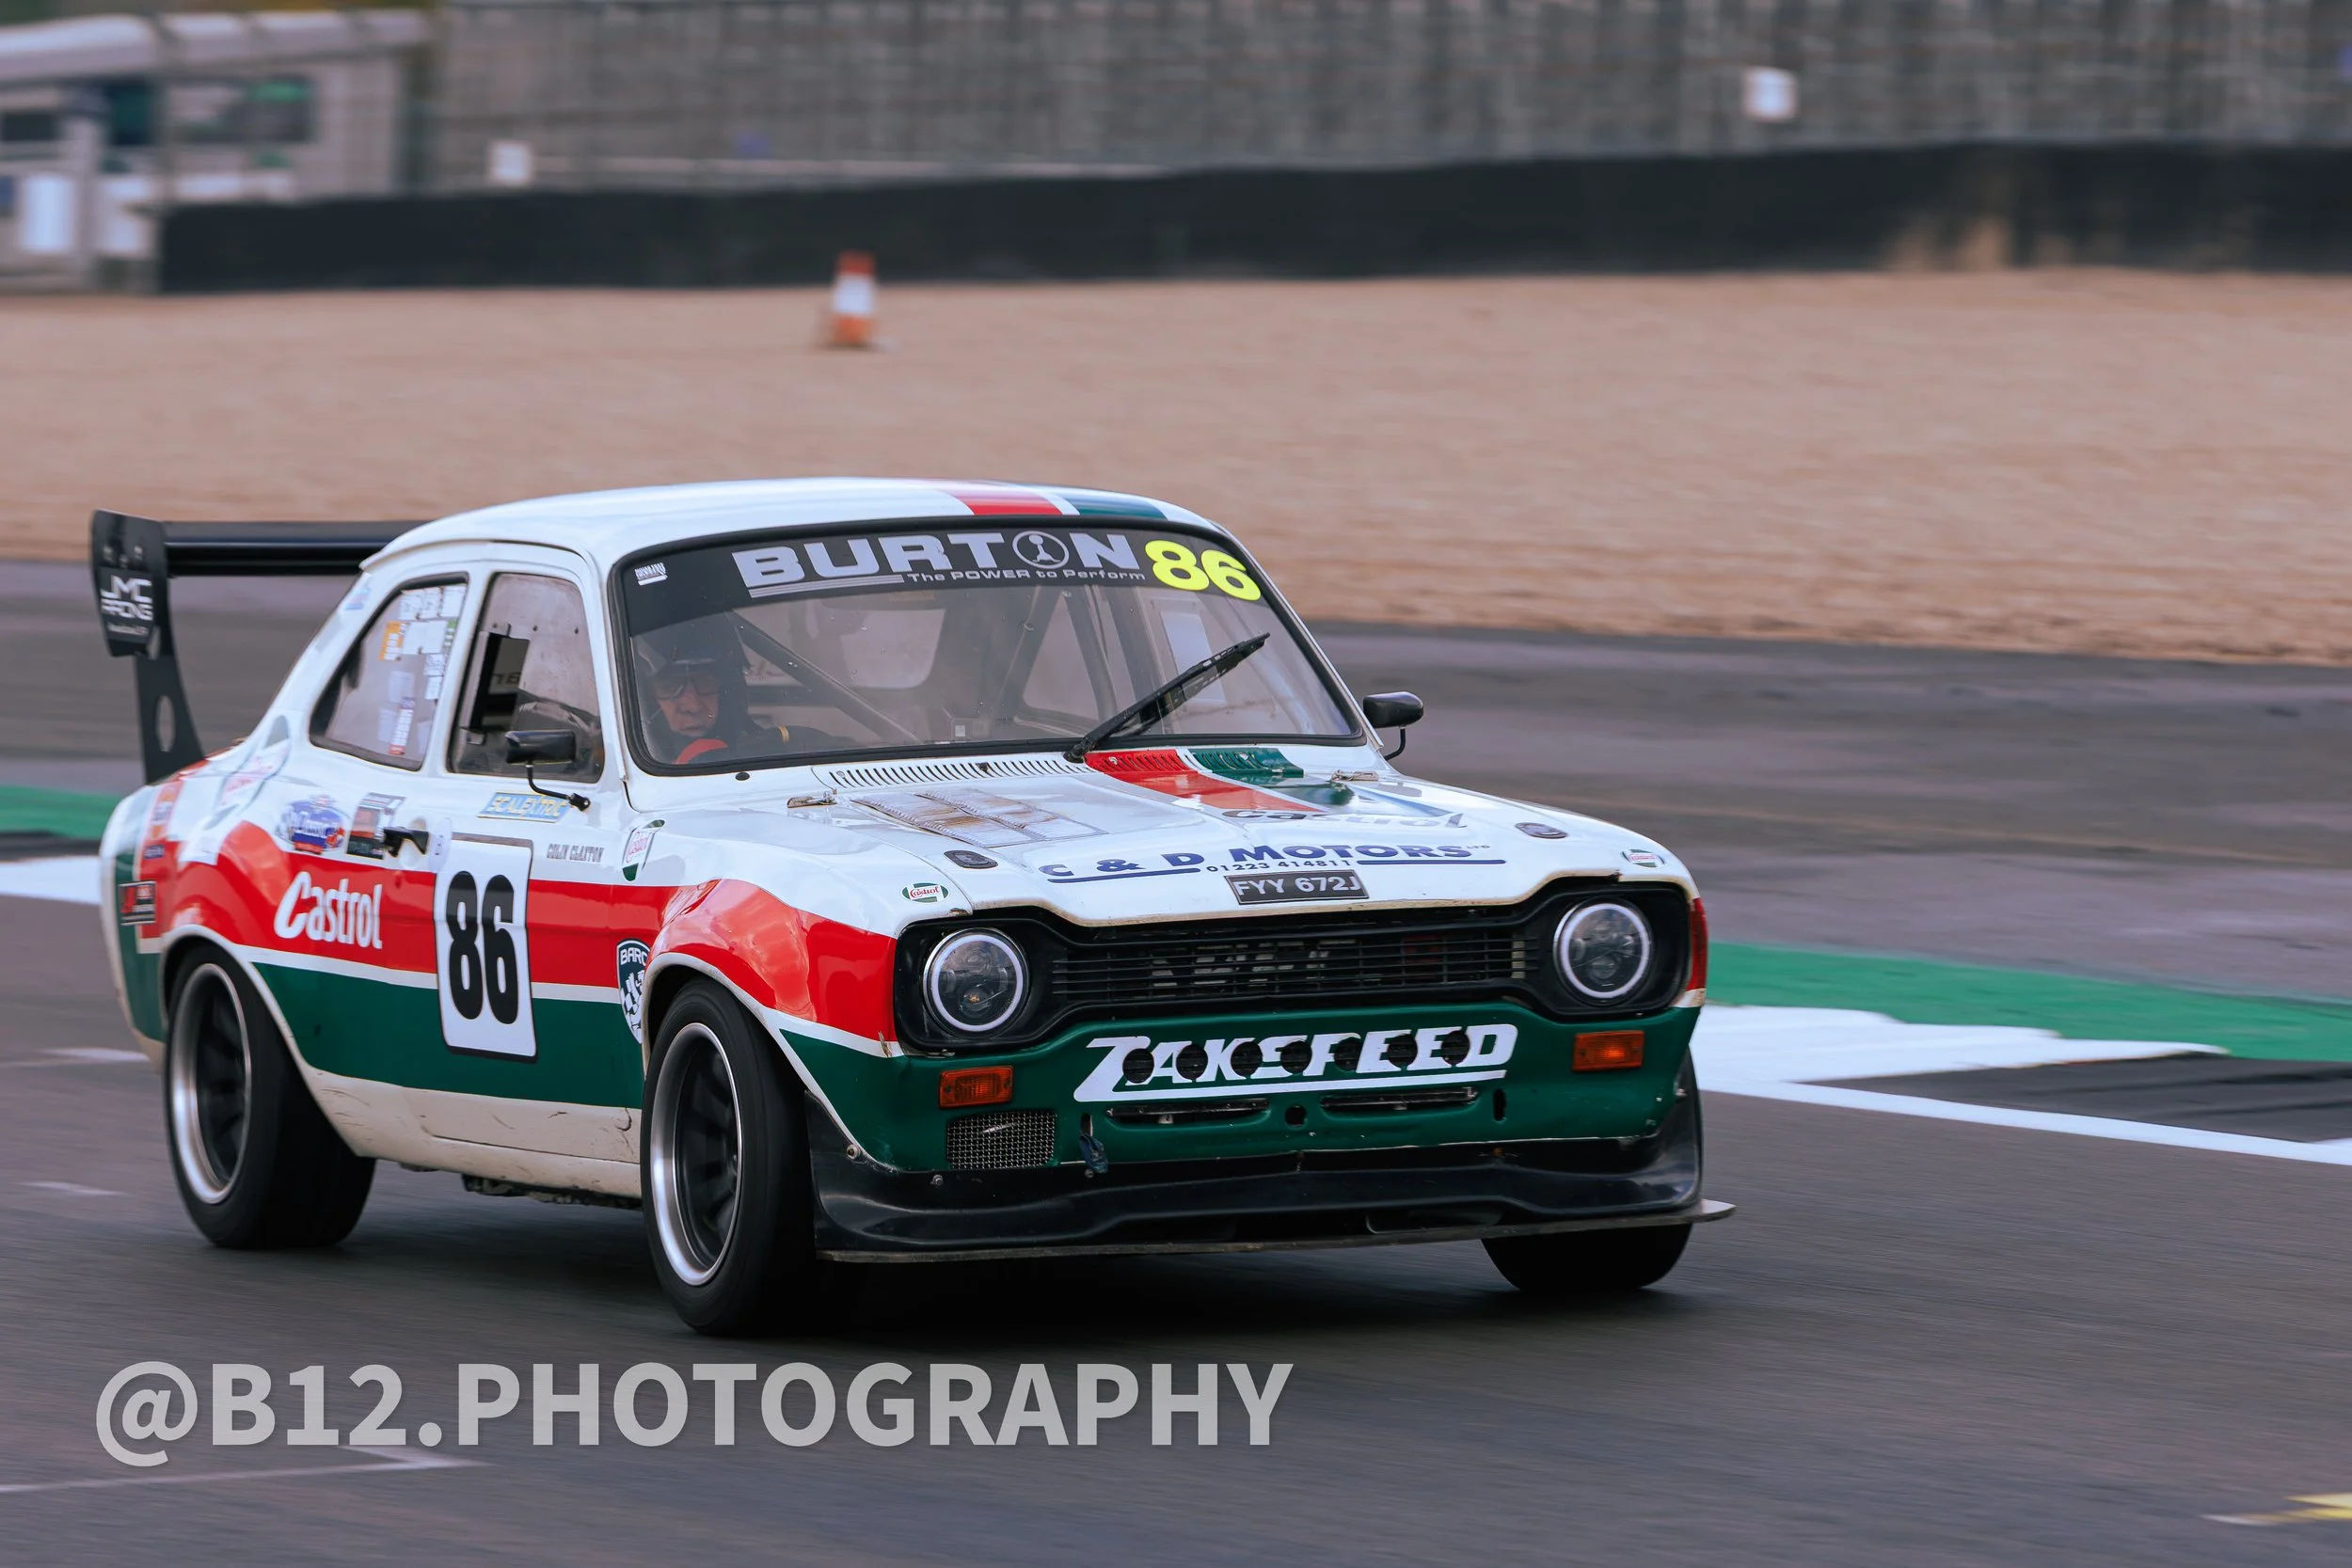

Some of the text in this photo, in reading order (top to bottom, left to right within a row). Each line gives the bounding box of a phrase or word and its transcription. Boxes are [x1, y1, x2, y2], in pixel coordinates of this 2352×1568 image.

[731, 531, 1139, 588] BURTON
[1144, 539, 1263, 602] 86
[100, 574, 153, 603] JMC
[908, 568, 1146, 582] The POWER to Perform
[485, 795, 567, 817] SCALEXTRIC
[1038, 863, 1074, 877] C
[1096, 858, 1146, 872] &
[1161, 852, 1205, 866] D
[1229, 844, 1472, 863] MOTORS
[1206, 859, 1352, 873] 01223 414811
[1232, 875, 1362, 896] FYY 672J
[273, 871, 383, 950] Castrol
[446, 870, 519, 1025] 86
[620, 946, 648, 966] BARC
